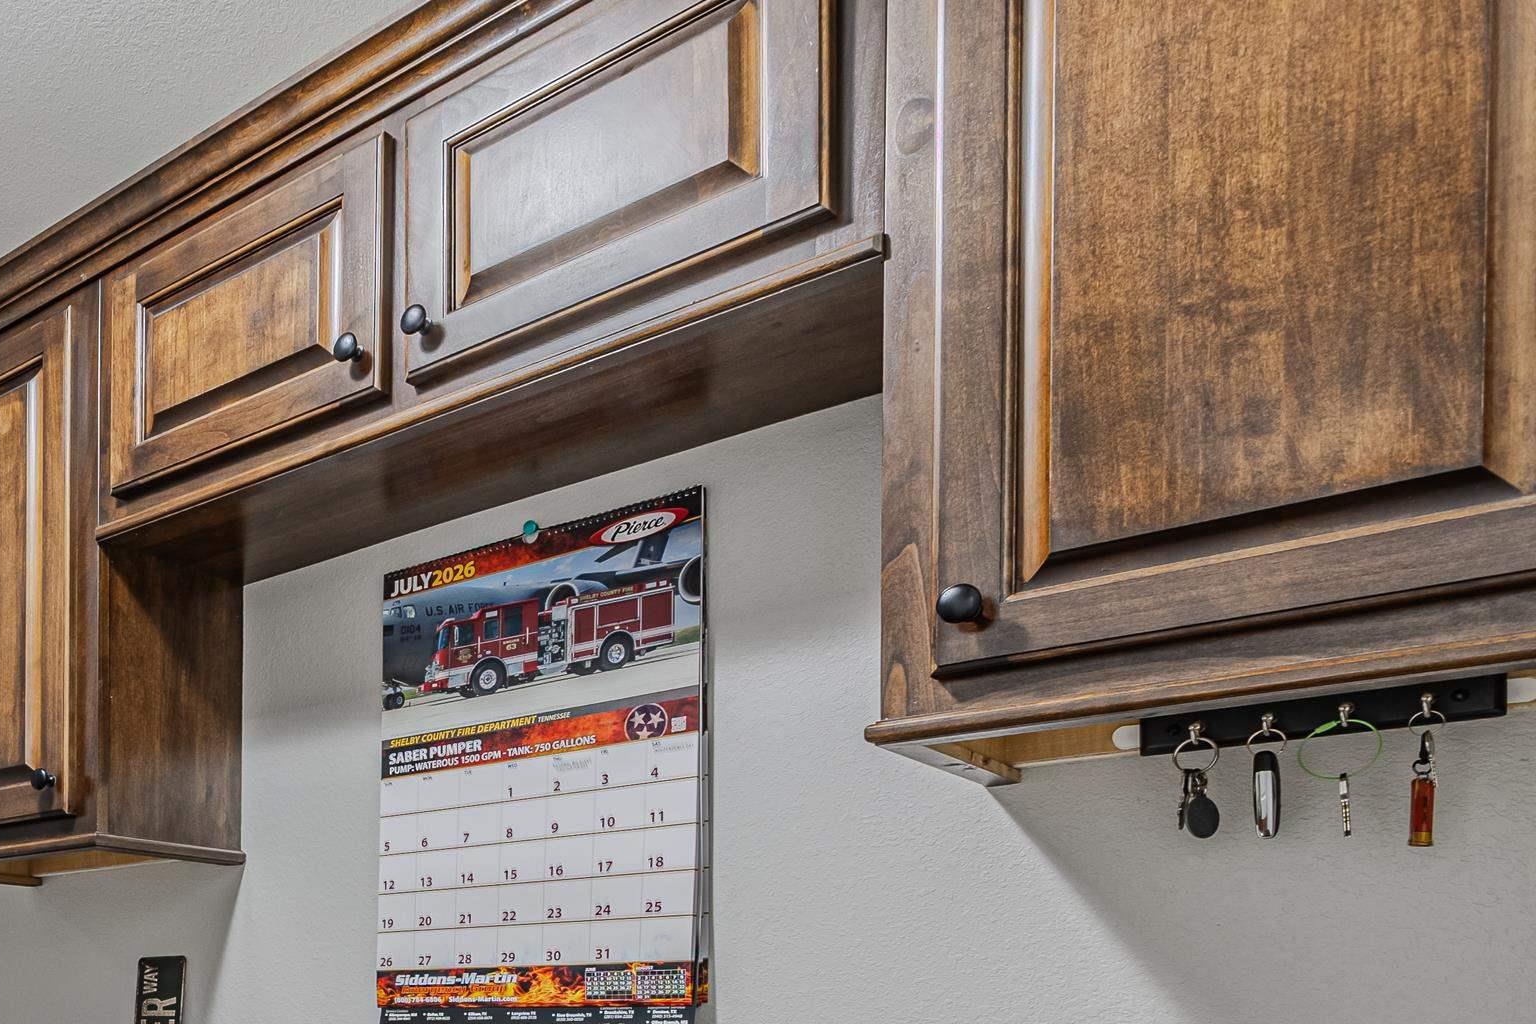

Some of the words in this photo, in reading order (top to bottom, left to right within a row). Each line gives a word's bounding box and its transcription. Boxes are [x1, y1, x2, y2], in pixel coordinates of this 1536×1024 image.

[611, 516, 665, 541] Pierce
[449, 603, 464, 615] AIR
[390, 736, 420, 748] SHELBY
[421, 730, 457, 743] COUNTY
[457, 726, 476, 737] FIRE
[477, 715, 537, 733] DEPARTMENT
[538, 711, 571, 723] TENNESSEE
[389, 748, 428, 765] SABER
[429, 739, 482, 758] PUMPER
[389, 763, 414, 775] PUMP:
[414, 756, 459, 771] WATEROUS
[461, 753, 480, 764] 1500
[481, 750, 501, 761] GPM
[507, 744, 533, 757] TANK:
[535, 741, 551, 752] 750
[552, 735, 596, 750] GALLONS
[508, 788, 512, 797] 1
[553, 781, 560, 791] 2
[602, 774, 608, 786] 3
[651, 767, 658, 779] 4
[384, 842, 389, 851] 5
[422, 838, 428, 847] 6
[464, 833, 469, 843] 7
[506, 828, 512, 839] 8
[552, 823, 558, 833] 9
[600, 817, 615, 828] 10
[650, 810, 663, 822] 11
[384, 880, 394, 890] 12
[420, 877, 432, 887] 13
[461, 873, 474, 885] 14
[504, 870, 517, 880] 15
[549, 865, 563, 876] 16
[598, 861, 613, 873] 17
[648, 856, 663, 869] 18
[382, 919, 393, 928] 19
[419, 916, 431, 926] 20
[459, 914, 471, 924] 21
[502, 911, 516, 921] 22
[547, 908, 562, 918] 23
[595, 905, 611, 917] 24
[645, 902, 661, 912] 25
[380, 957, 392, 967] 26
[419, 956, 431, 965] 27
[458, 954, 471, 964] 28
[501, 953, 515, 962] 29
[546, 951, 561, 961] 30
[596, 948, 609, 959] 31
[142, 965, 159, 994] WAY
[395, 973, 517, 986] Siddons-Martin
